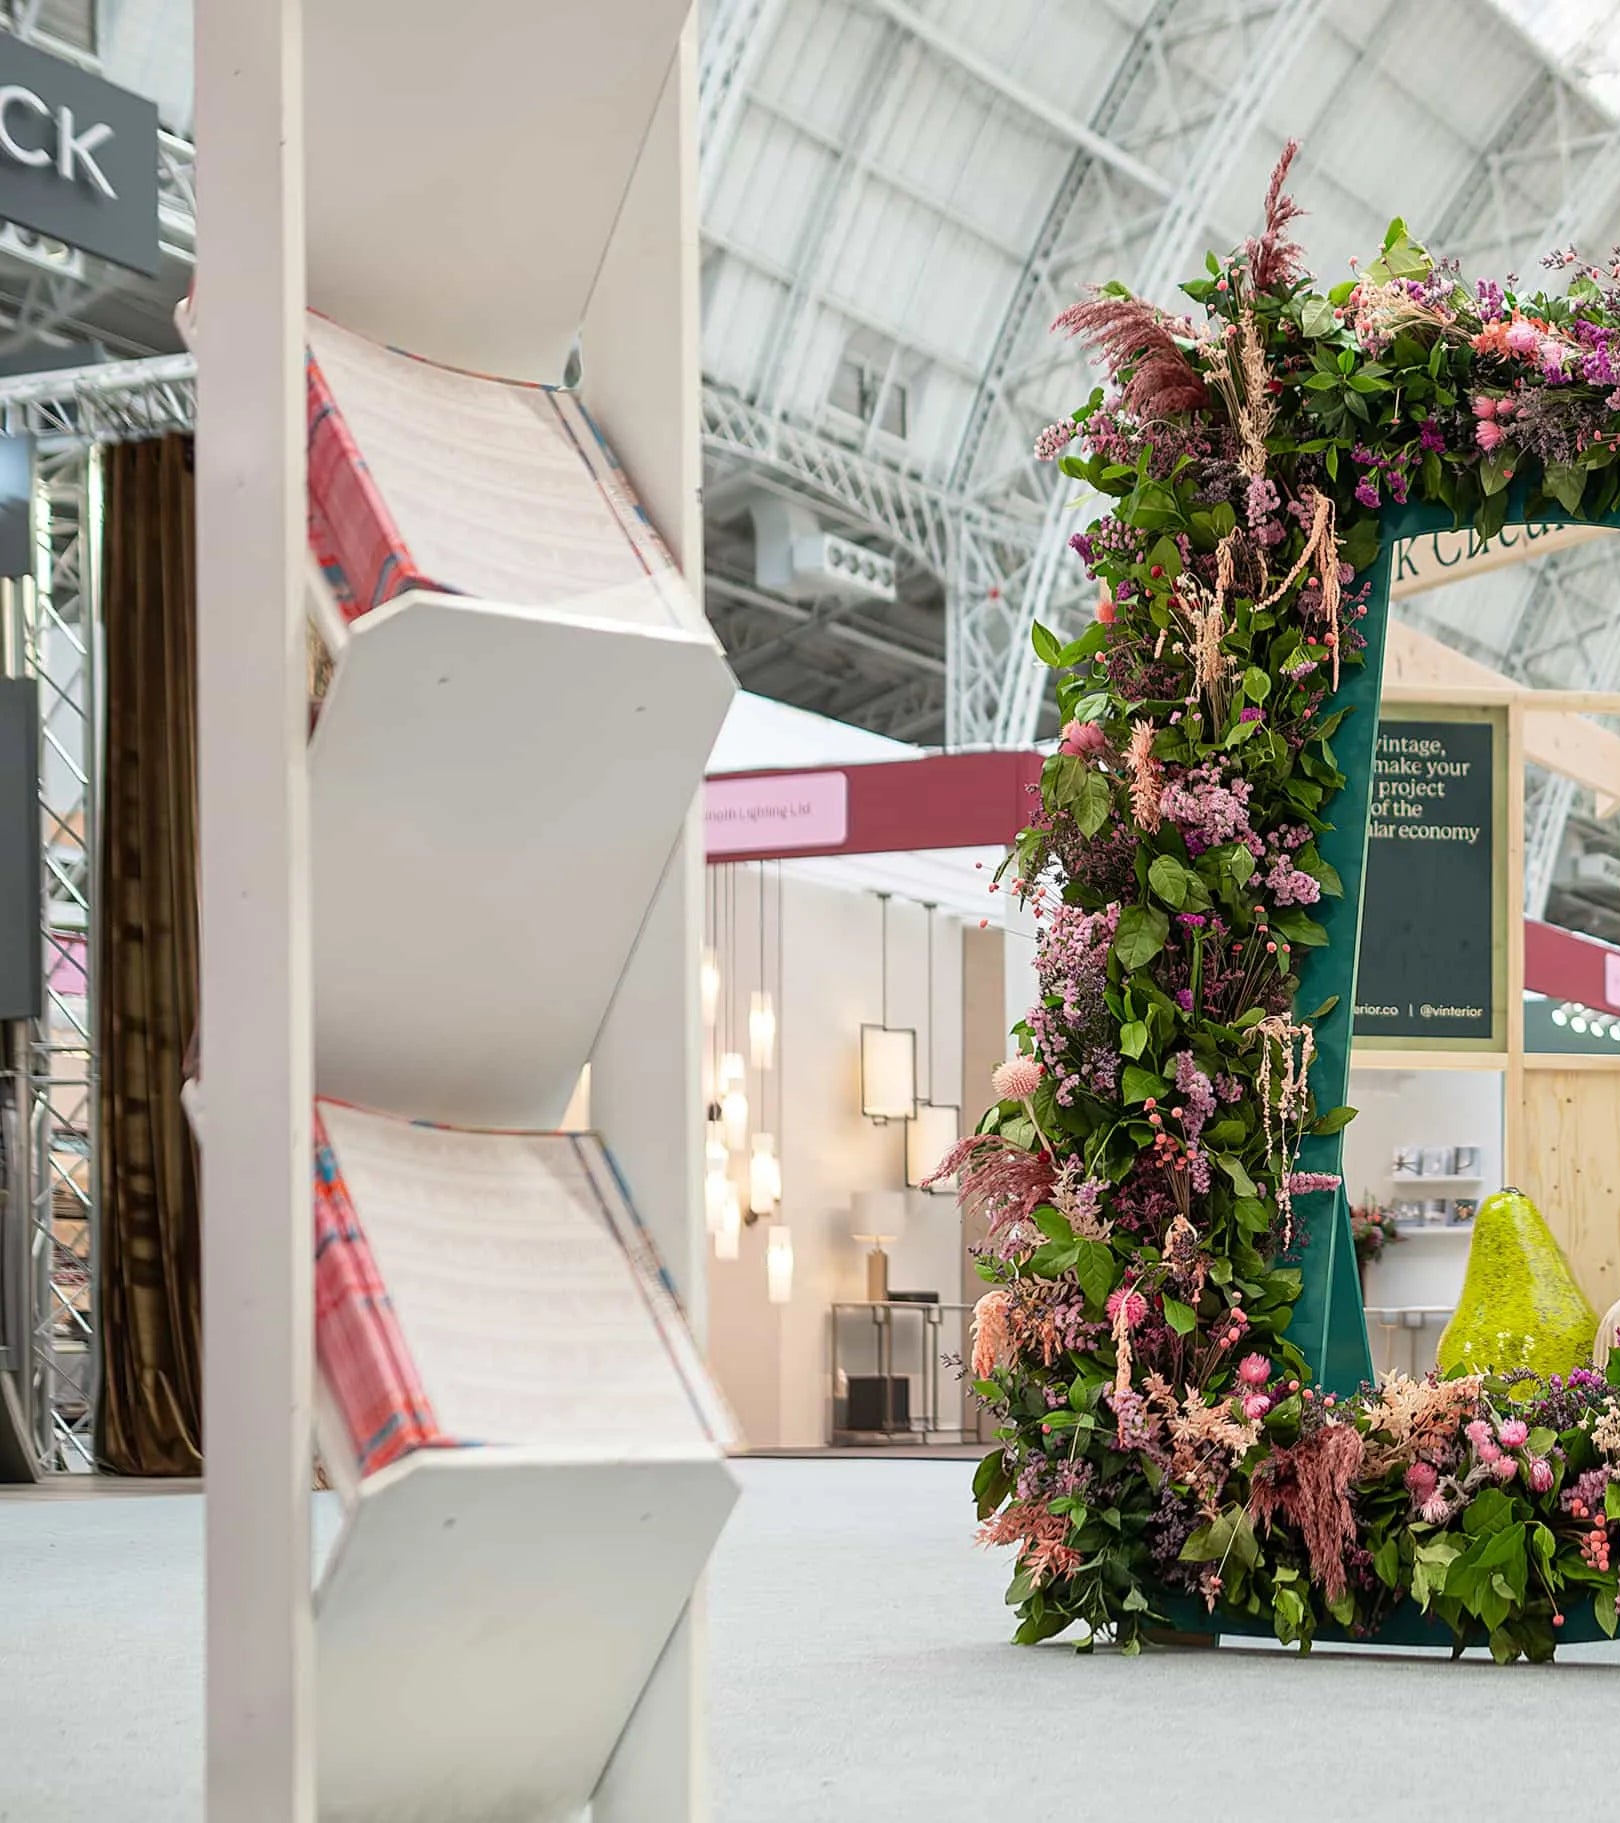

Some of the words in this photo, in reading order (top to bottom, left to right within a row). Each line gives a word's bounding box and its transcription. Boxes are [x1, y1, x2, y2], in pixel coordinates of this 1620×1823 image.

[1374, 756, 1423, 775] make
[1426, 761, 1471, 779] your
[1378, 778, 1446, 799] project
[1371, 799, 1392, 817] of
[1393, 799, 1423, 817] the
[1398, 825, 1480, 844] economy
[1420, 1003, 1483, 1018] @vinterior
